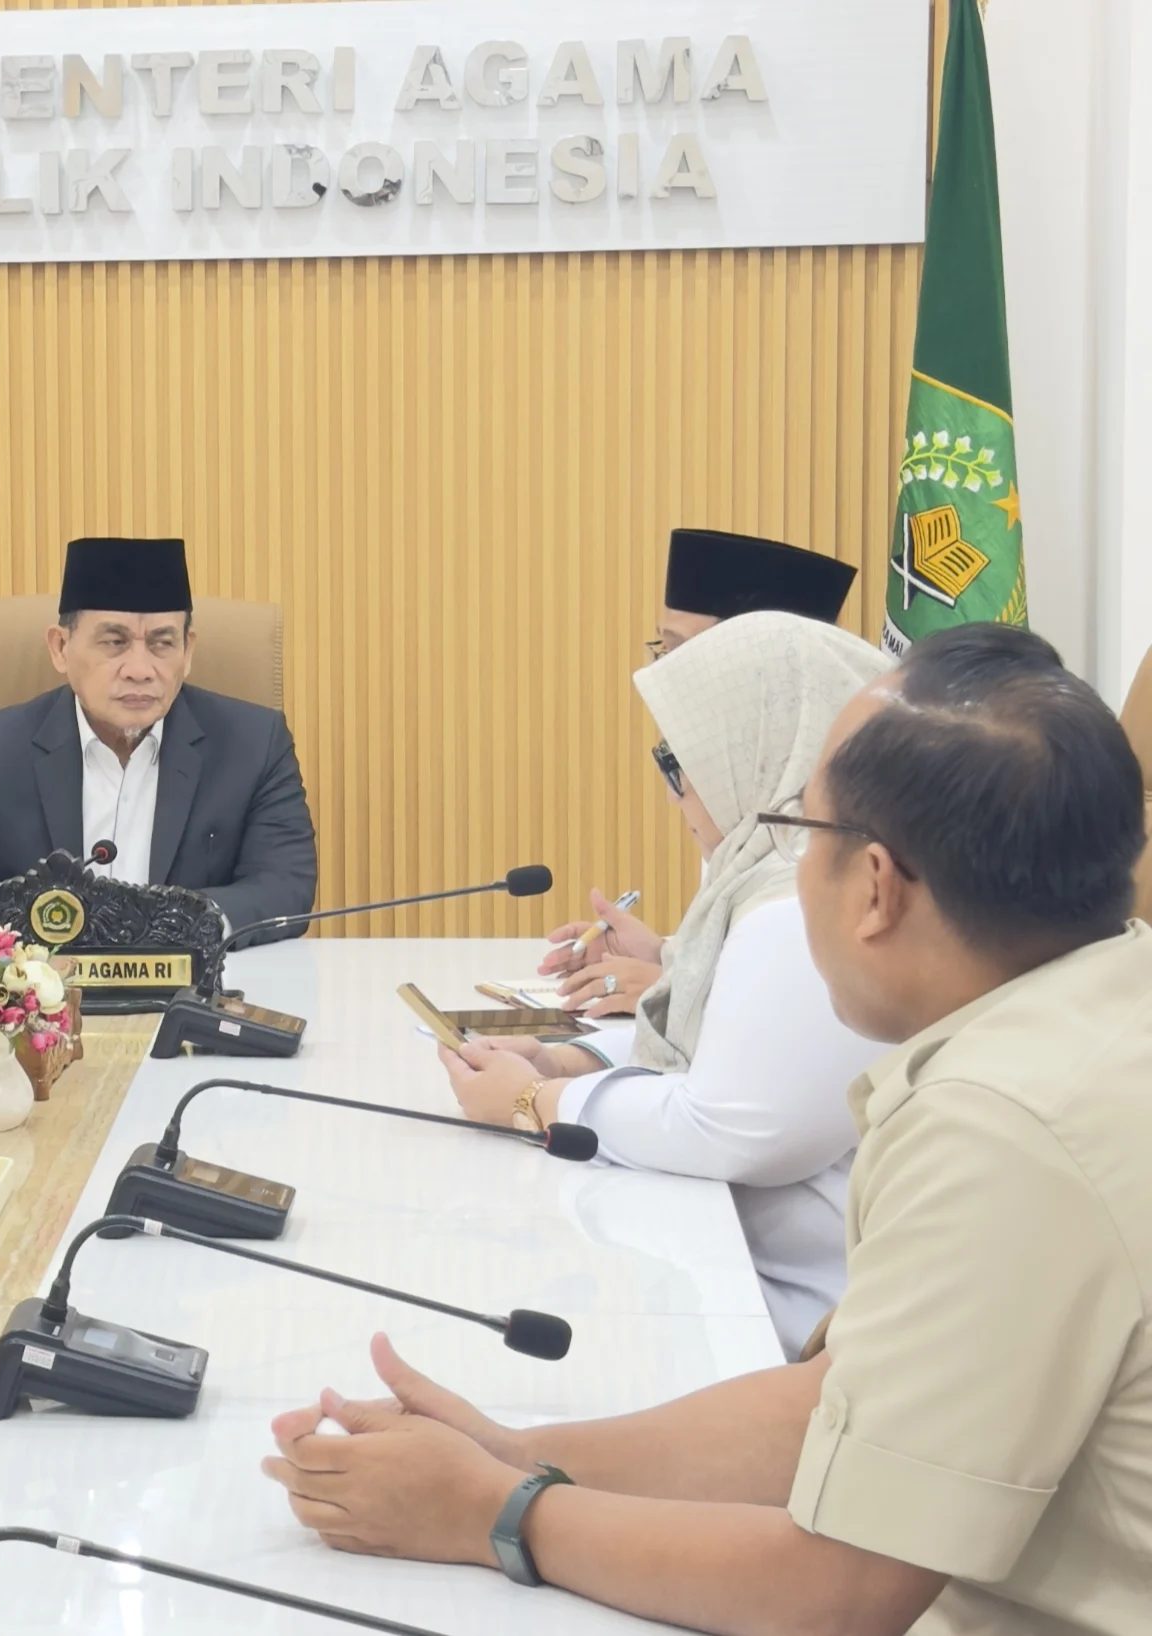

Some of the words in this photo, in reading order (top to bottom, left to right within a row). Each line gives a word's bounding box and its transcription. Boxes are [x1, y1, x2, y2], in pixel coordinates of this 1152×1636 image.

[395, 35, 769, 111] AGAMA
[171, 132, 718, 212] INDONESIA
[88, 962, 149, 978] AGAMA
[154, 962, 172, 979] RI
